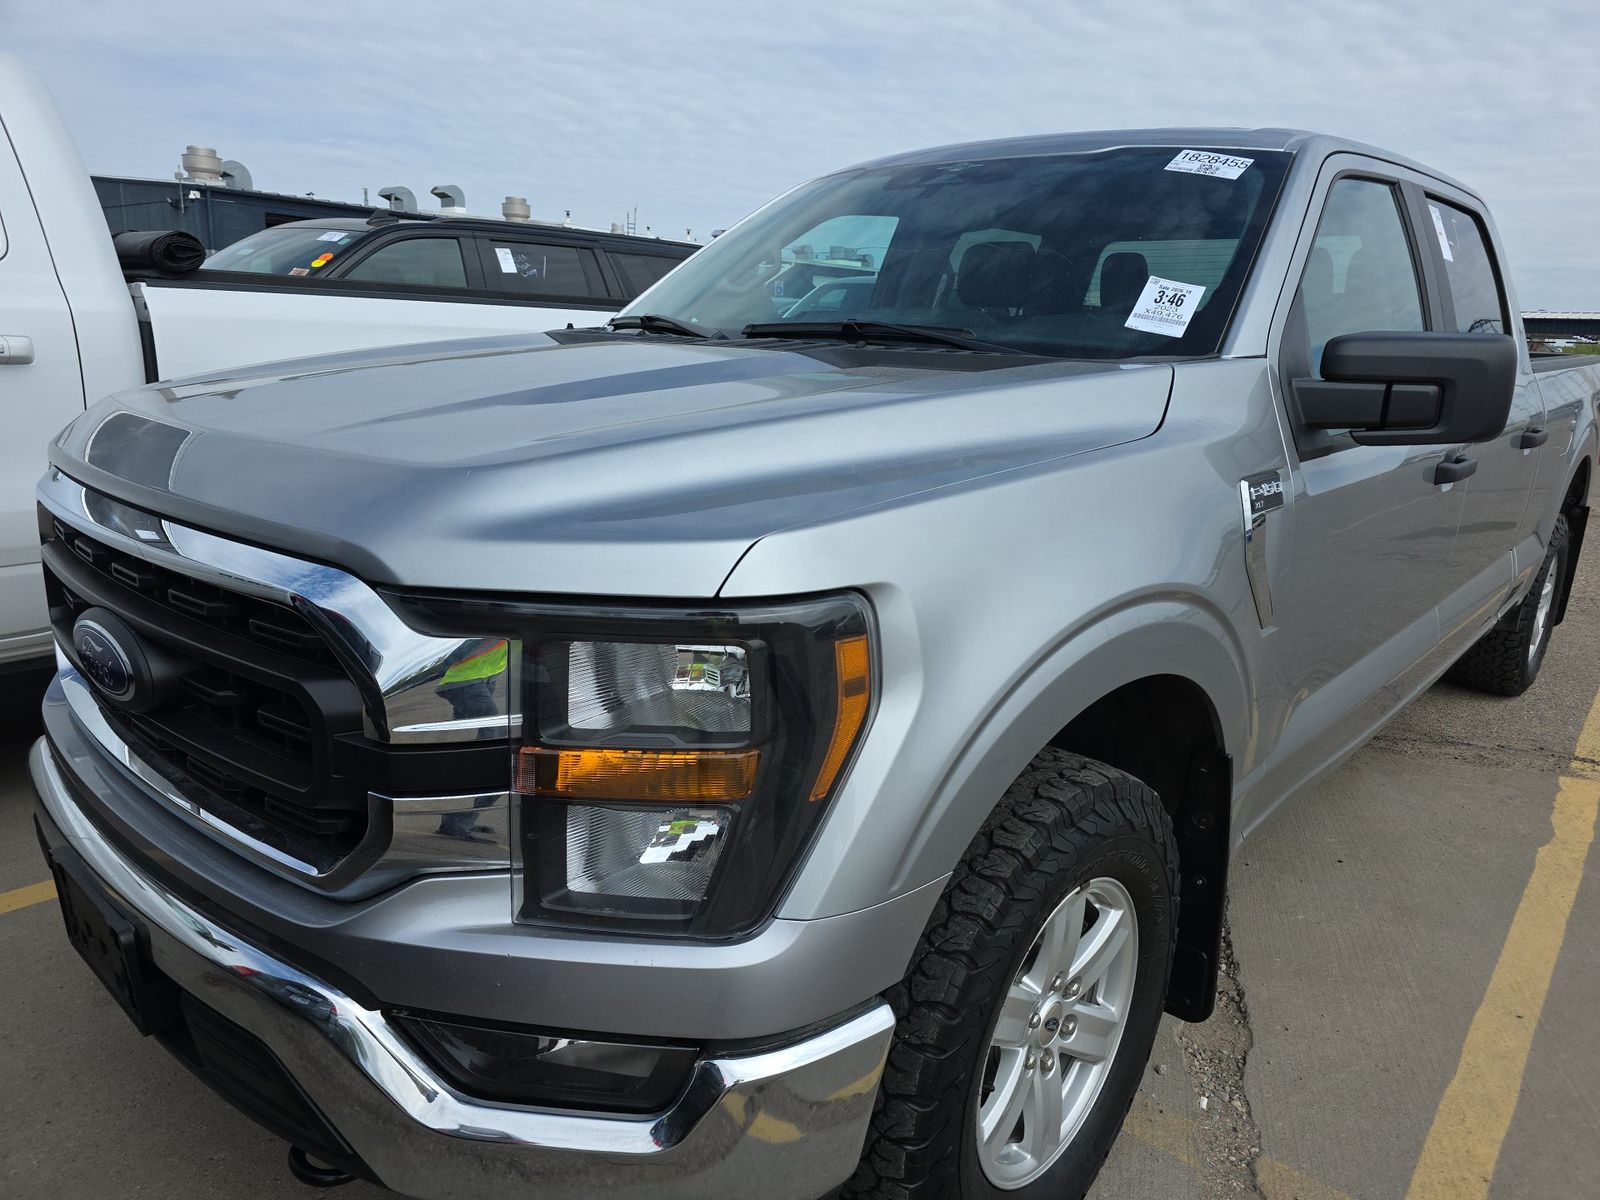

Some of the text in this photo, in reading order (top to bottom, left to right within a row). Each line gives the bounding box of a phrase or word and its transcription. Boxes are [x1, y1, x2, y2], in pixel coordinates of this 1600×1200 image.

[1182, 152, 1248, 169] 1828455
[1154, 290, 1186, 307] 3:46
[1143, 307, 1184, 320] X49,476
[1154, 304, 1179, 313] 2023
[1254, 500, 1265, 510] XLT
